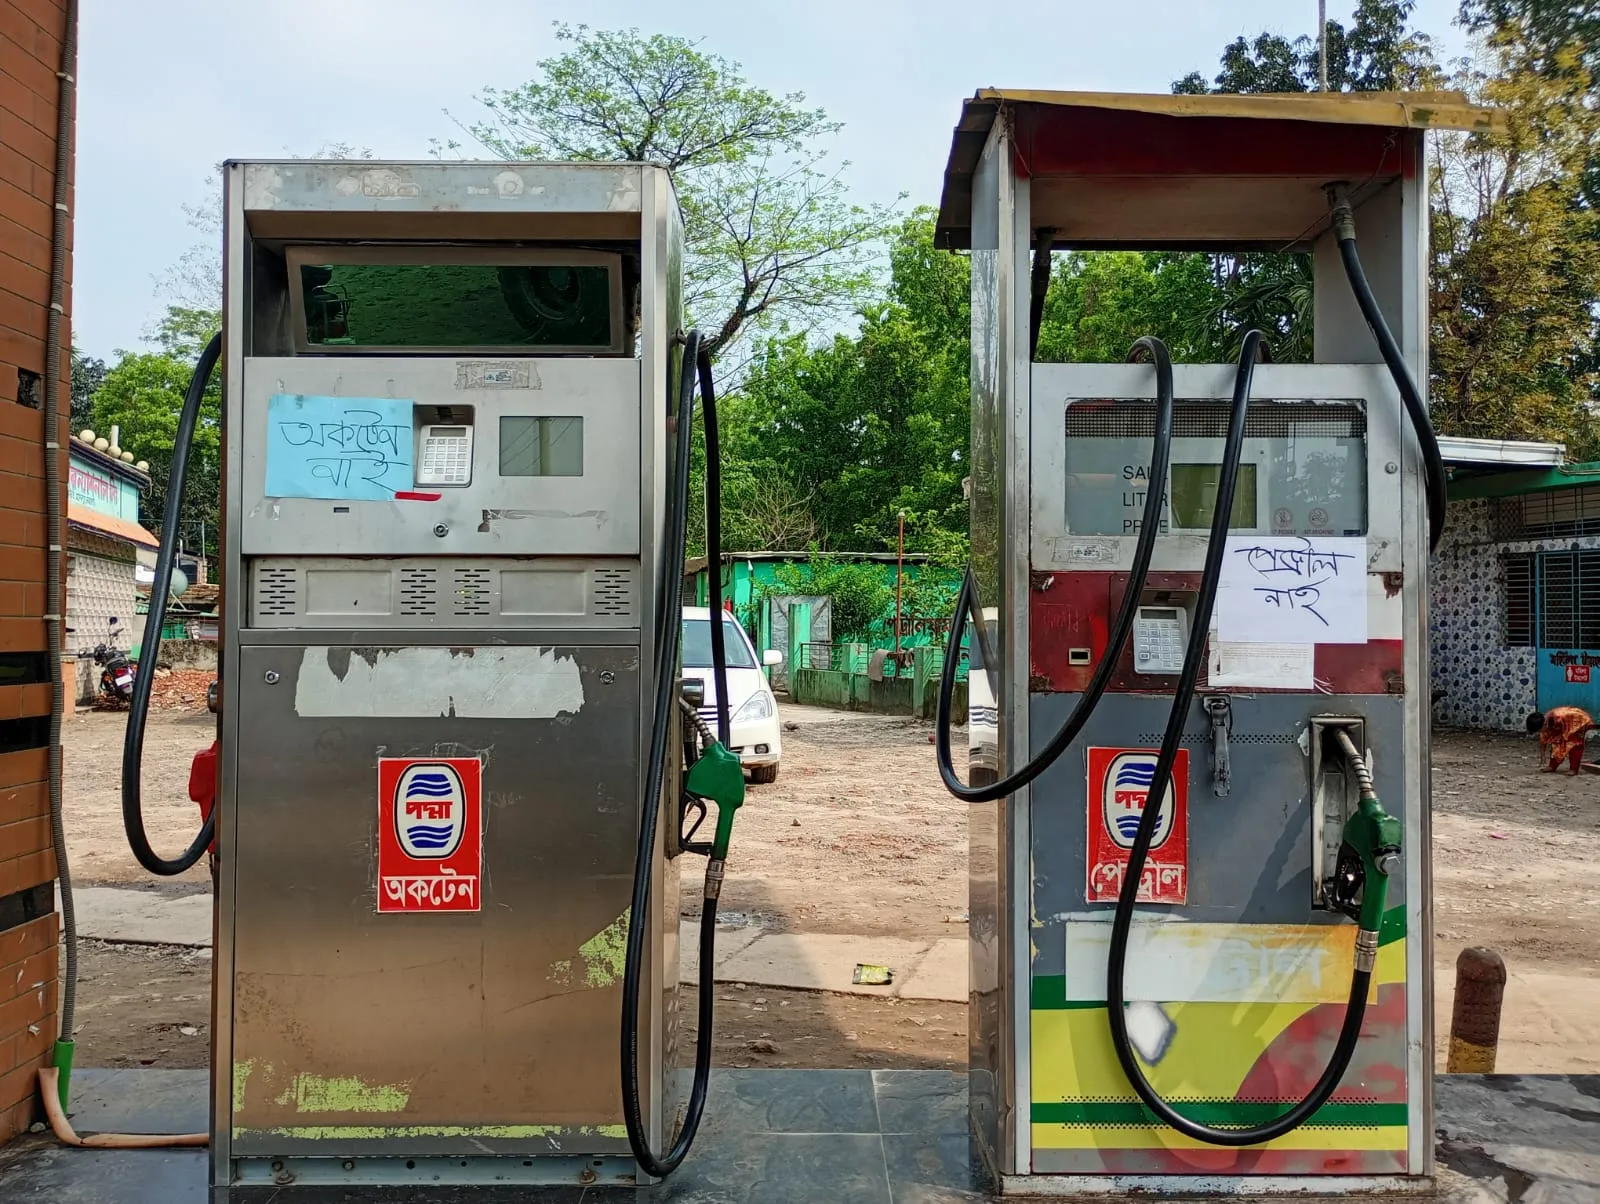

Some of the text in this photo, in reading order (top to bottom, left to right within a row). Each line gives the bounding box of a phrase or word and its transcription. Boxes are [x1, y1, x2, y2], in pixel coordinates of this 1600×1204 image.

[278, 409, 411, 456] অকটেন
[306, 450, 410, 494] নাই
[1122, 465, 1168, 480] SAL
[1123, 492, 1169, 507] LITR
[1123, 519, 1169, 534] PRE
[1252, 576, 1330, 627] নাই
[405, 801, 454, 820] পদ্মা
[381, 863, 478, 909] অকটেন
